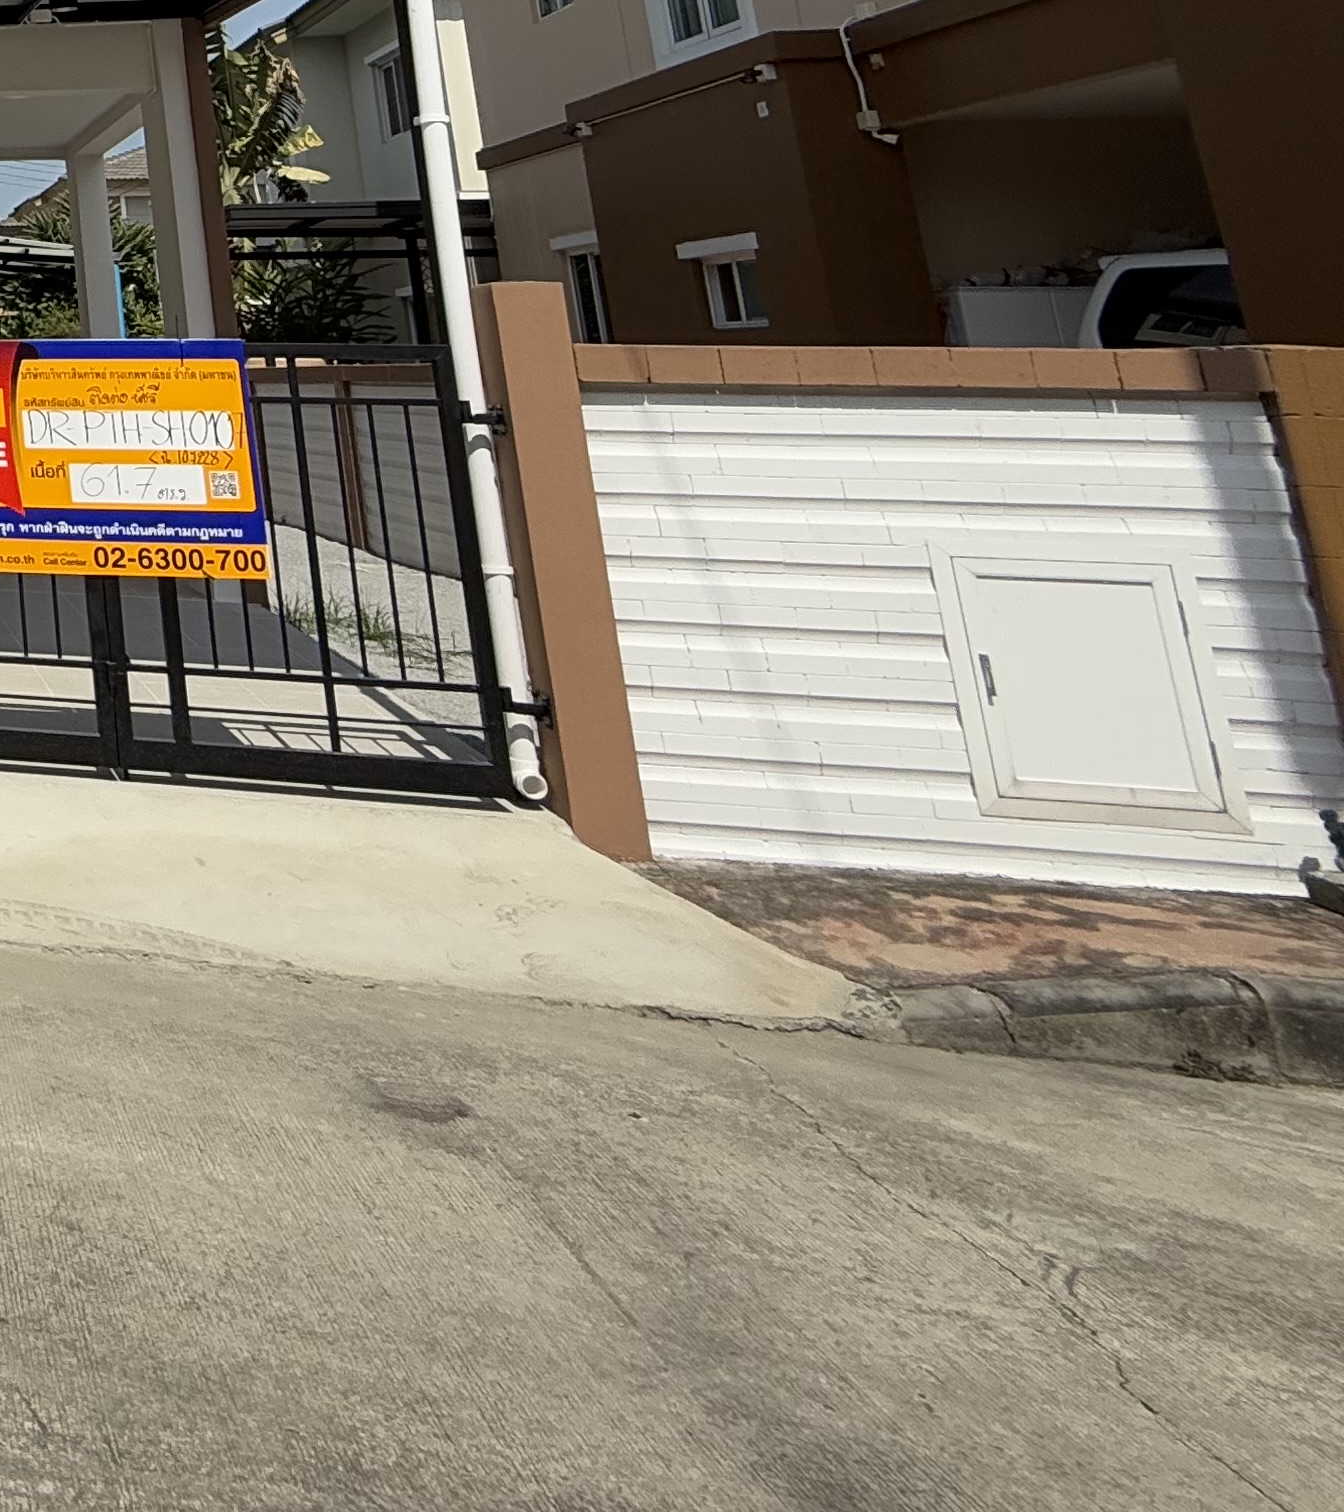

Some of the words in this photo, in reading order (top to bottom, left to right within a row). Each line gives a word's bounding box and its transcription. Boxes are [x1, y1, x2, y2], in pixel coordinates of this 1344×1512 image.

[86, 385, 128, 406] ติดต่อ
[30, 459, 67, 479] เนื้อที่
[80, 462, 157, 500] 61.7
[19, 520, 243, 540] หากฝ่าฝืนจะถูกดำเนินคดีตามกฎหมาย
[43, 557, 59, 565] Call
[94, 546, 266, 573] 02-6300-700
